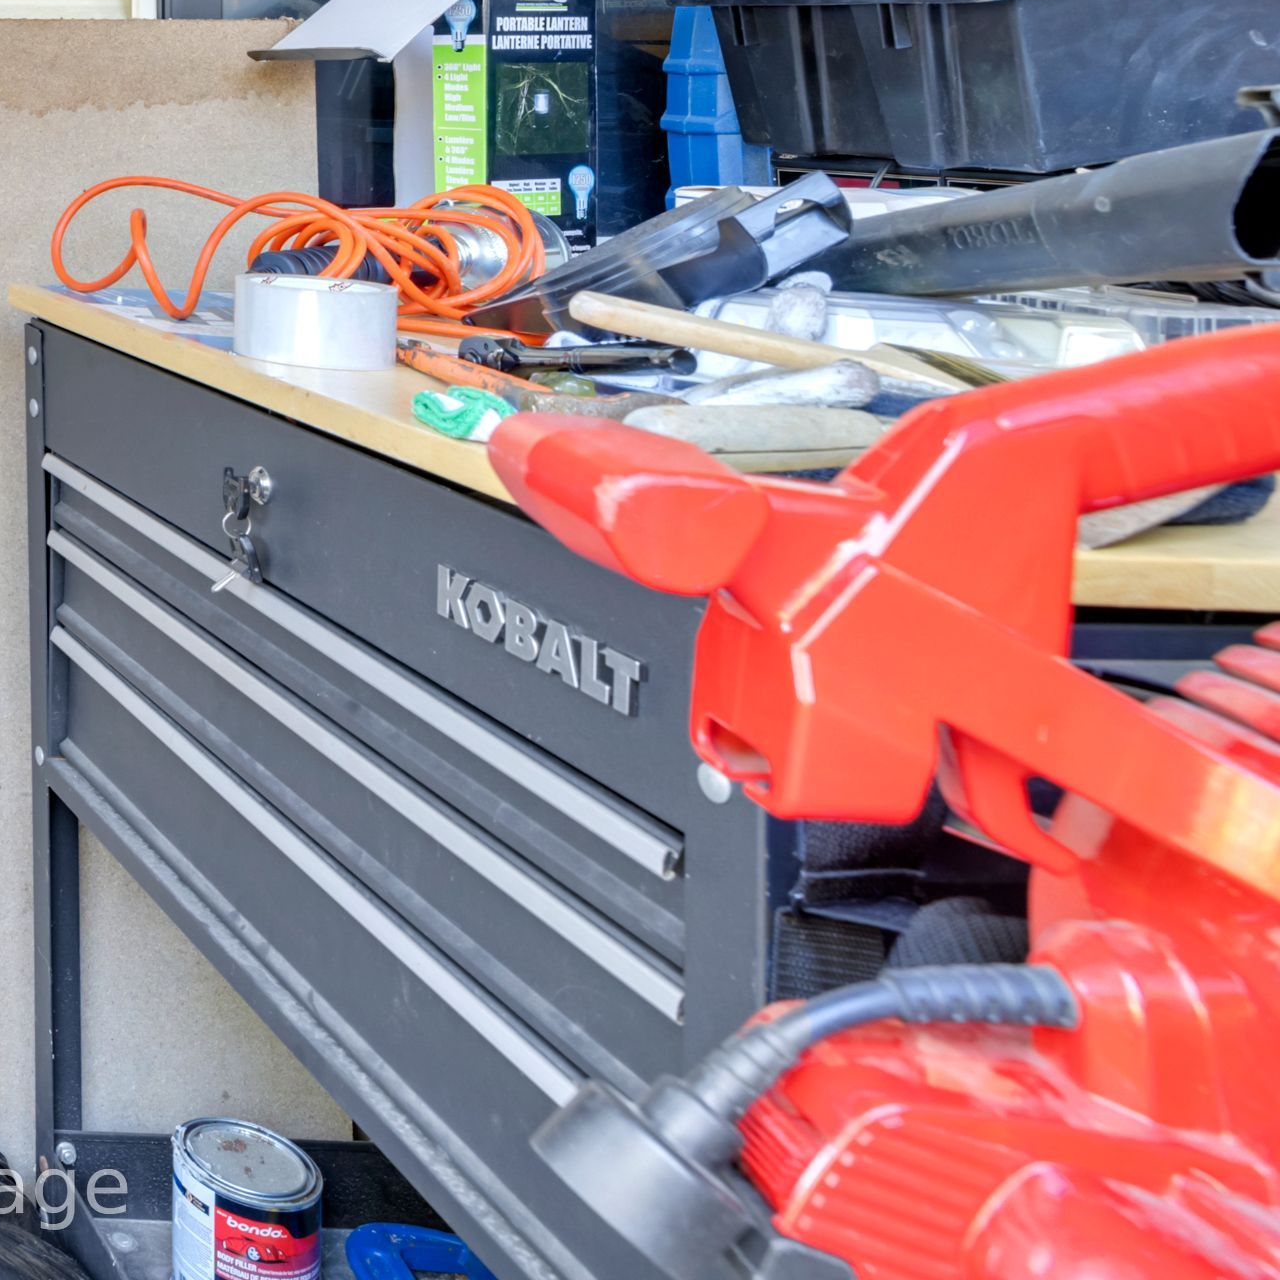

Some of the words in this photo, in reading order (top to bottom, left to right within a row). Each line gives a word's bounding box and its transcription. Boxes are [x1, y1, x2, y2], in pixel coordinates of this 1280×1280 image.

[496, 17, 545, 31] PORTABLE
[546, 17, 588, 31] LANTERN
[492, 35, 539, 50] LANTERNE
[541, 35, 593, 49] PORTATIVE
[437, 564, 640, 716] KOBALT
[226, 1216, 282, 1238] bondo
[217, 1250, 235, 1266] BODY
[235, 1259, 257, 1272] FILLER
